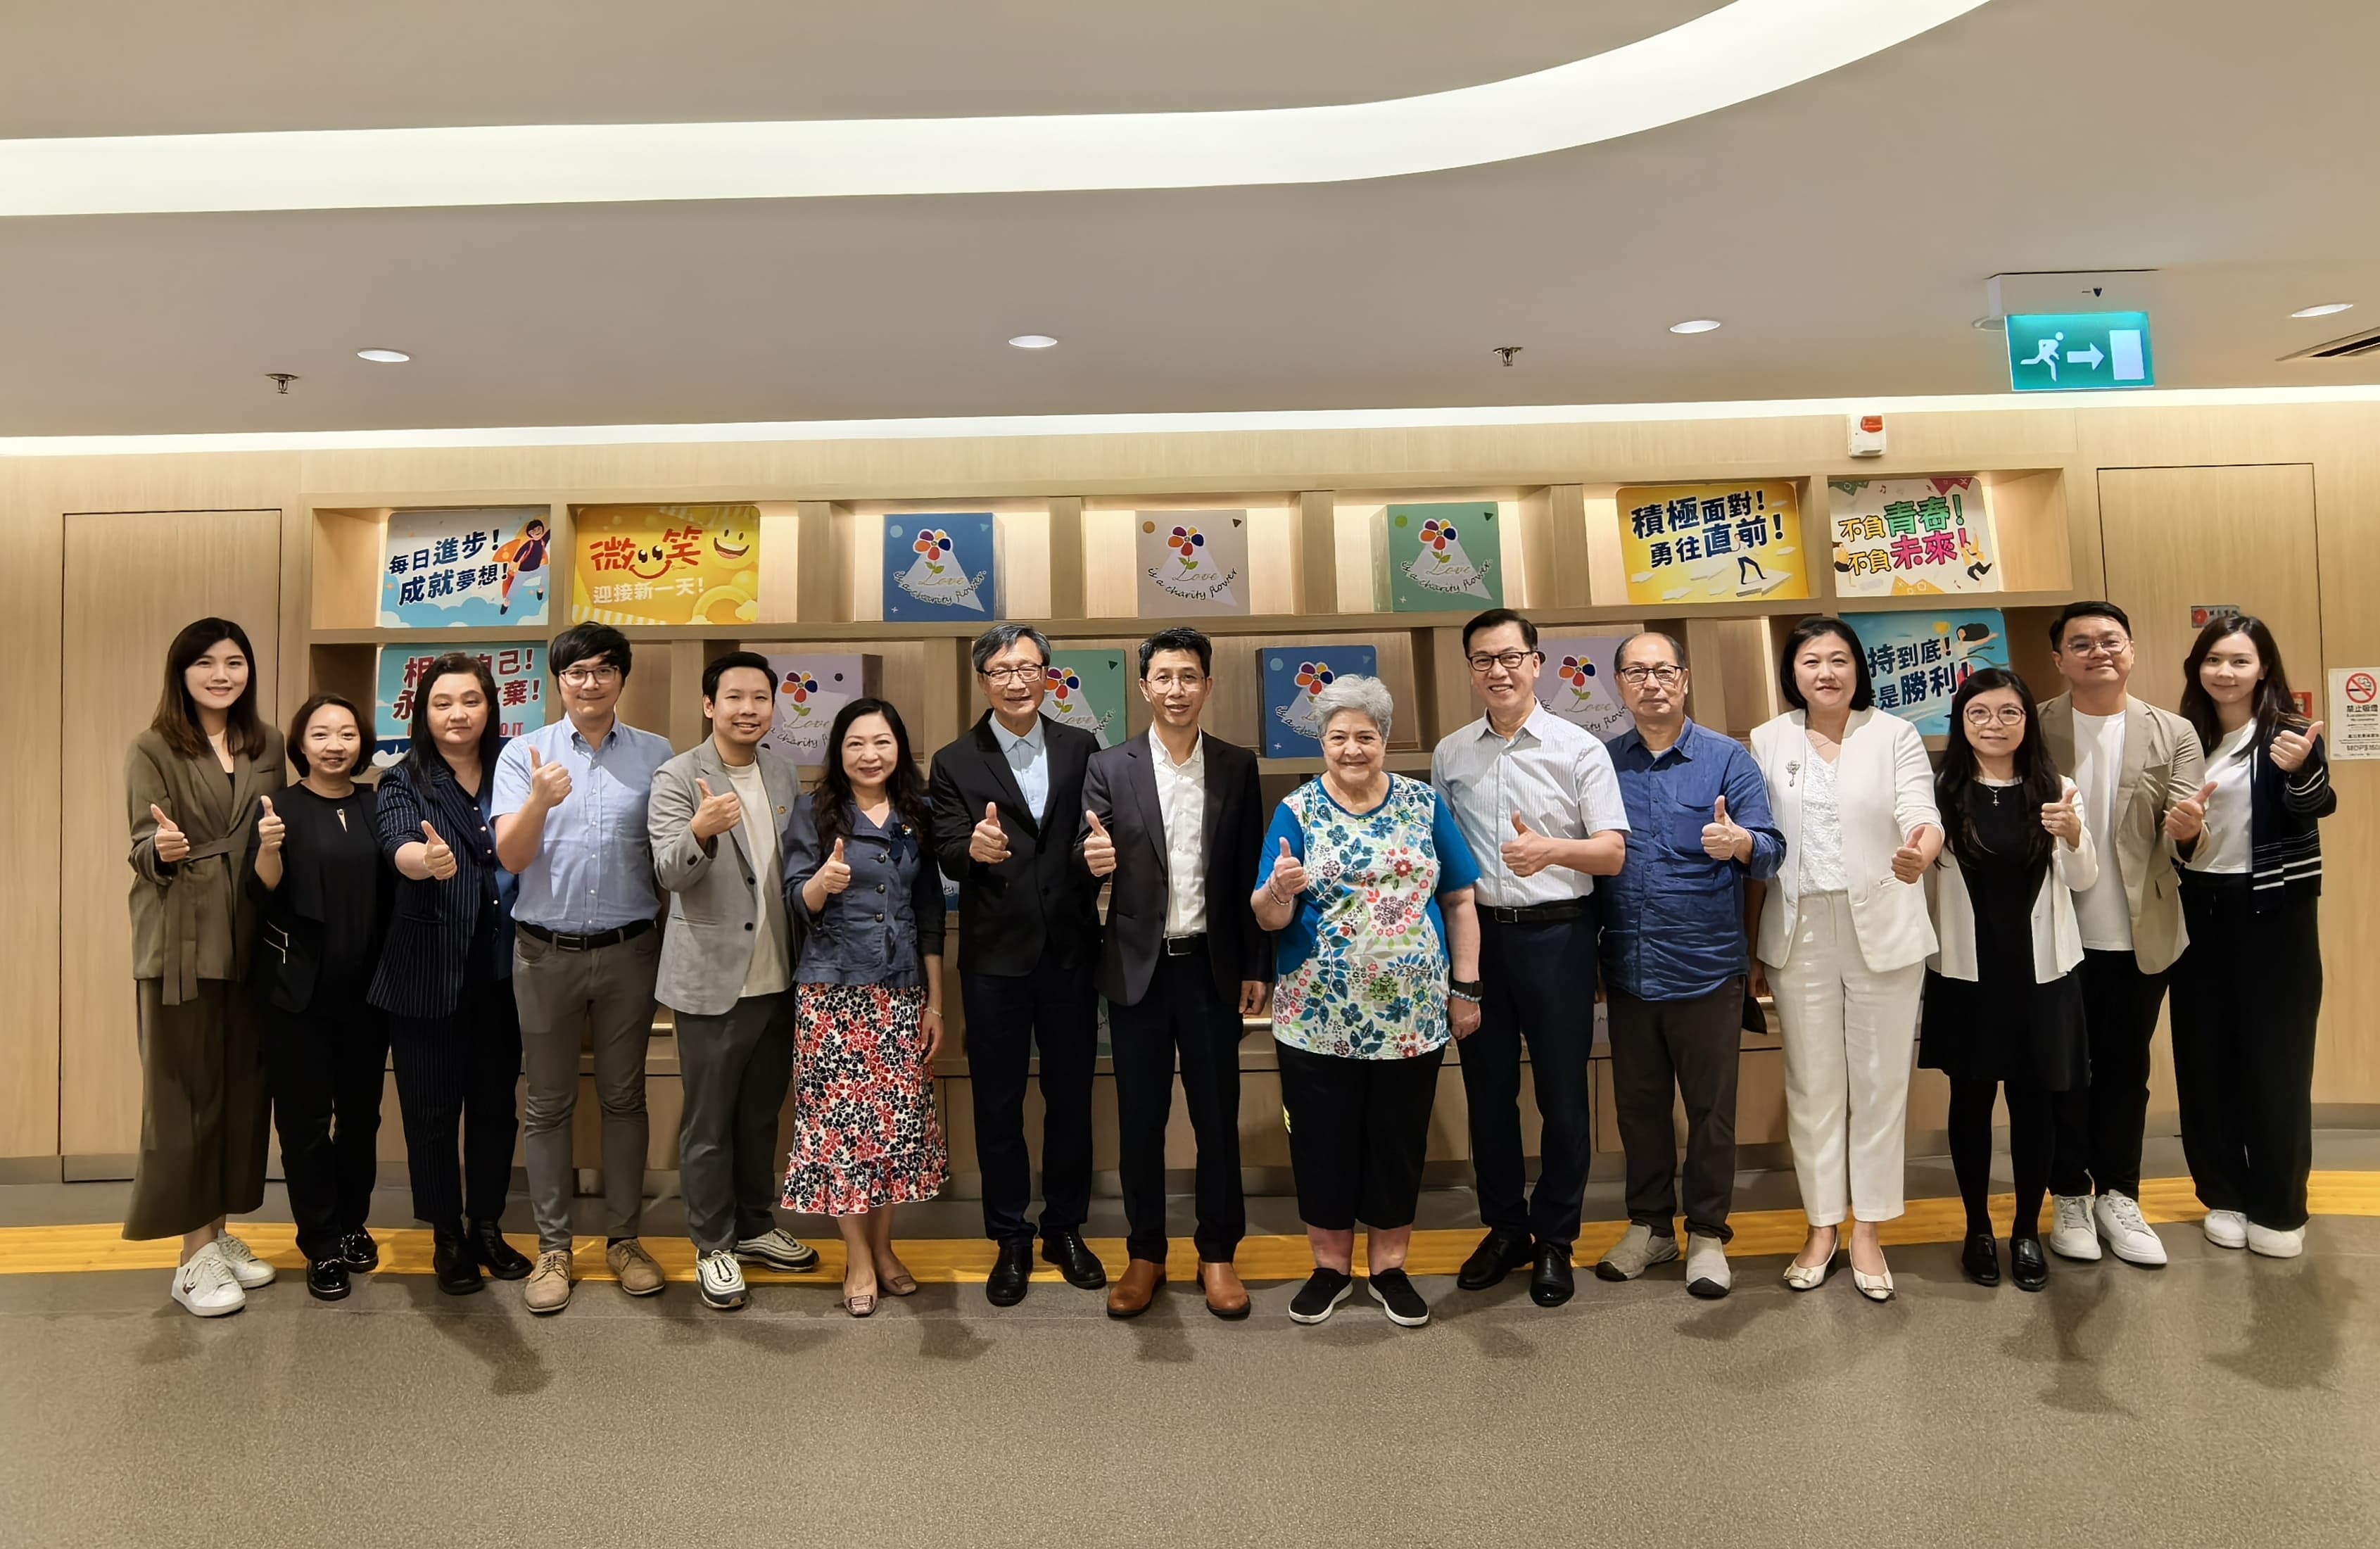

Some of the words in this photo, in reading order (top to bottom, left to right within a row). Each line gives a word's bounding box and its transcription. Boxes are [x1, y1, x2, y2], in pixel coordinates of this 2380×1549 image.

[1631, 490, 1764, 540] 積極面對!
[1838, 494, 1965, 542] 不負青春!
[388, 529, 500, 574] 每日進步!
[589, 525, 703, 571] 微笑
[1650, 514, 1783, 568] 勇往直前!
[1847, 528, 1967, 576] 不負未來!
[398, 562, 508, 606] 成就夢想!
[918, 570, 964, 586] Love
[1172, 567, 1217, 581] Love
[1419, 580, 1460, 593] charity
[1426, 562, 1471, 576] Love
[593, 576, 704, 604] 迎接新一天!
[912, 590, 952, 605] charity
[1165, 586, 1205, 600] charity
[1867, 636, 1951, 678] 持到底!
[777, 733, 818, 749] charity
